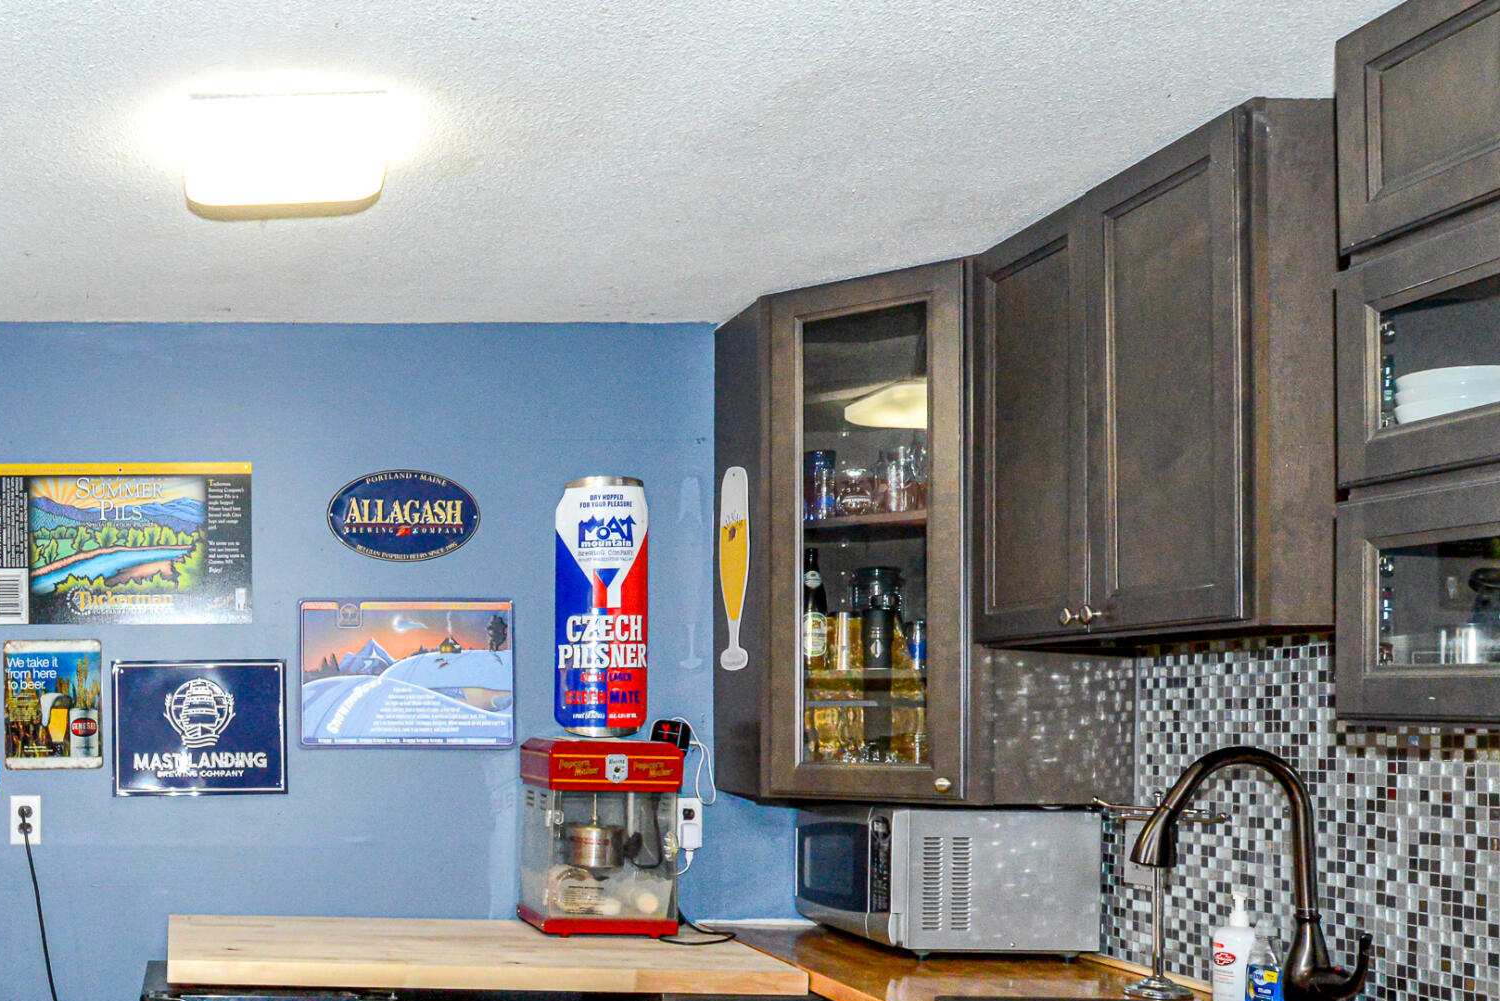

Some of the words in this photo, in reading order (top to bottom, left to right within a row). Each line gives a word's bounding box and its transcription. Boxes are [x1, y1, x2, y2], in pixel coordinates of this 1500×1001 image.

[366, 472, 412, 485] PORTLAND
[420, 472, 447, 487] MAINE
[76, 477, 164, 500] SUMMER
[100, 500, 142, 521] PILS
[345, 497, 463, 525] ALLAGASH
[344, 526, 394, 535] BREWING
[412, 526, 464, 535] COMPANY
[581, 539, 631, 548] mountain
[75, 592, 172, 610] Tuckerman
[566, 614, 643, 642] CZECH
[6, 657, 24, 668] We
[26, 657, 50, 668] take
[52, 656, 58, 668] it
[558, 644, 647, 669] PILSNER
[6, 668, 31, 678] from
[32, 668, 57, 678] here
[581, 672, 605, 682] STLE
[609, 673, 632, 682] LAGER
[8, 680, 18, 690] to
[20, 680, 46, 690] beer.
[566, 690, 606, 705] CZECH
[610, 691, 640, 704] MATE
[133, 752, 184, 770] MAST
[190, 752, 268, 769] LANDING
[559, 759, 590, 770] Popcorn
[634, 761, 665, 771] Popcorn
[157, 770, 197, 778] BREWING
[200, 770, 244, 778] COMPANY
[574, 768, 599, 776] Maker
[648, 769, 674, 778] Maker
